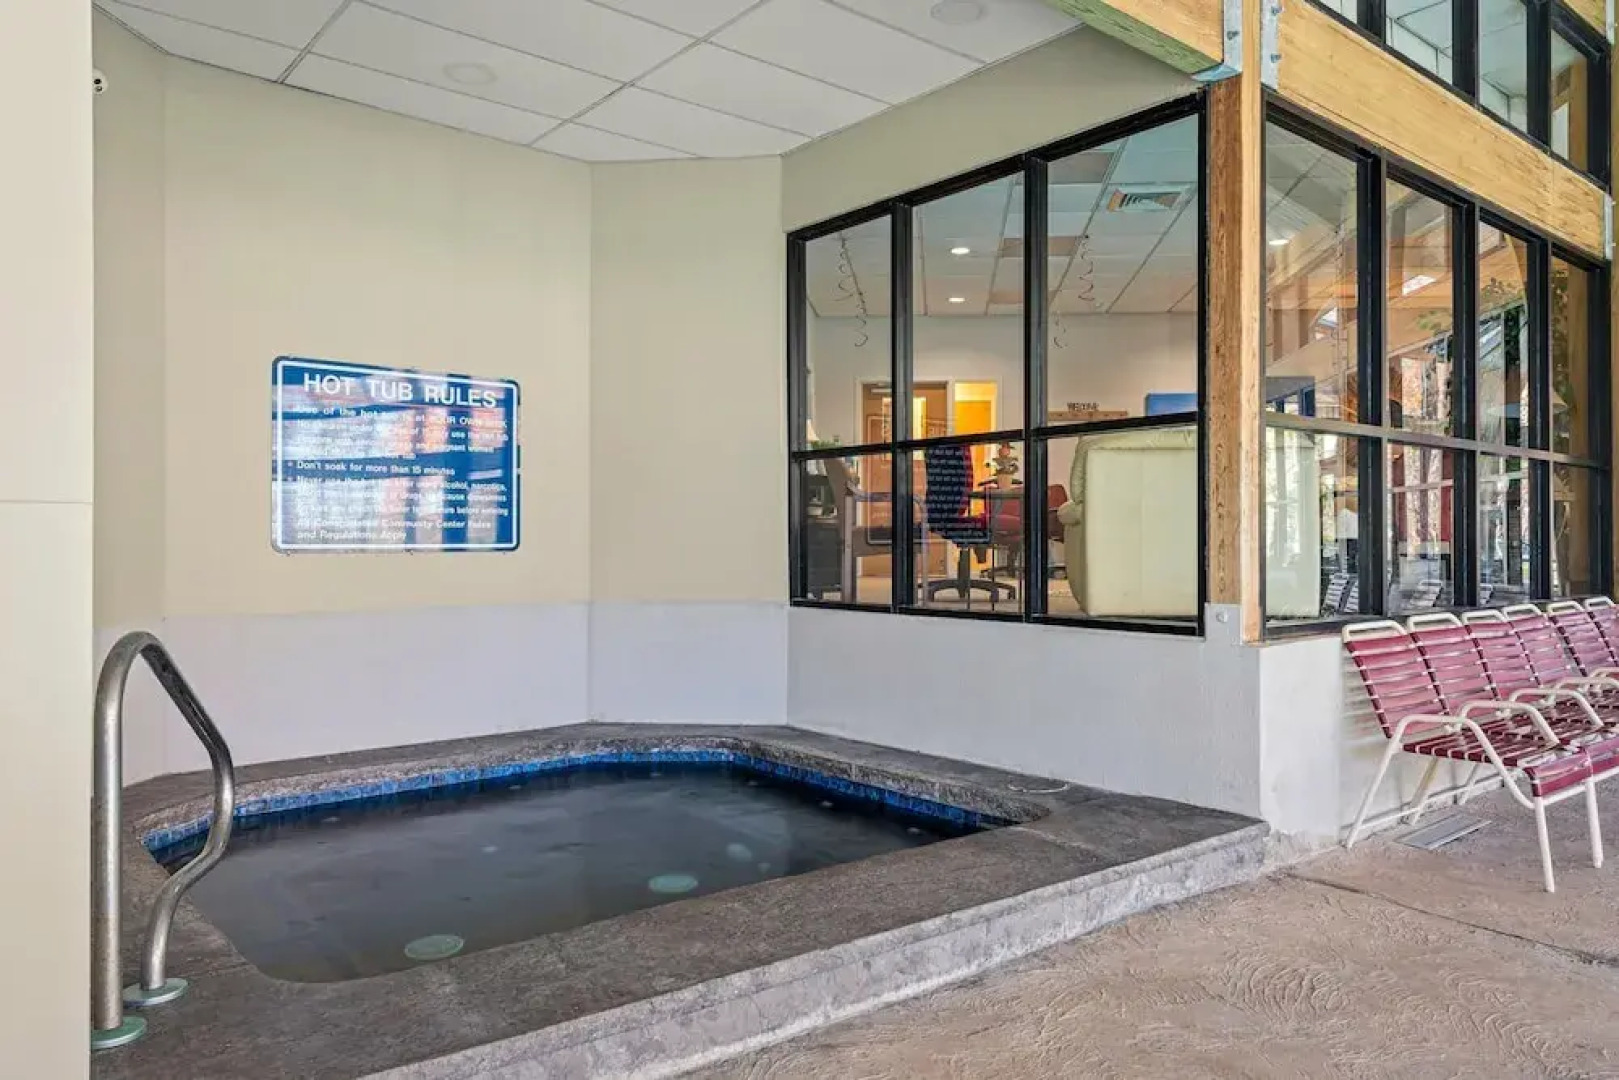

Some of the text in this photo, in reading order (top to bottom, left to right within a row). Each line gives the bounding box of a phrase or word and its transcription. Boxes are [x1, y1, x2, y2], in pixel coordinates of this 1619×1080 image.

[304, 373, 497, 407] HOT TUB RULES
[324, 406, 335, 415] of
[361, 409, 377, 418] hot
[297, 460, 321, 469] Don't
[325, 462, 347, 471] soak
[349, 462, 363, 471] for
[365, 465, 388, 473] more
[391, 466, 409, 474] than
[423, 467, 456, 476] minutes
[436, 519, 466, 529] Center
